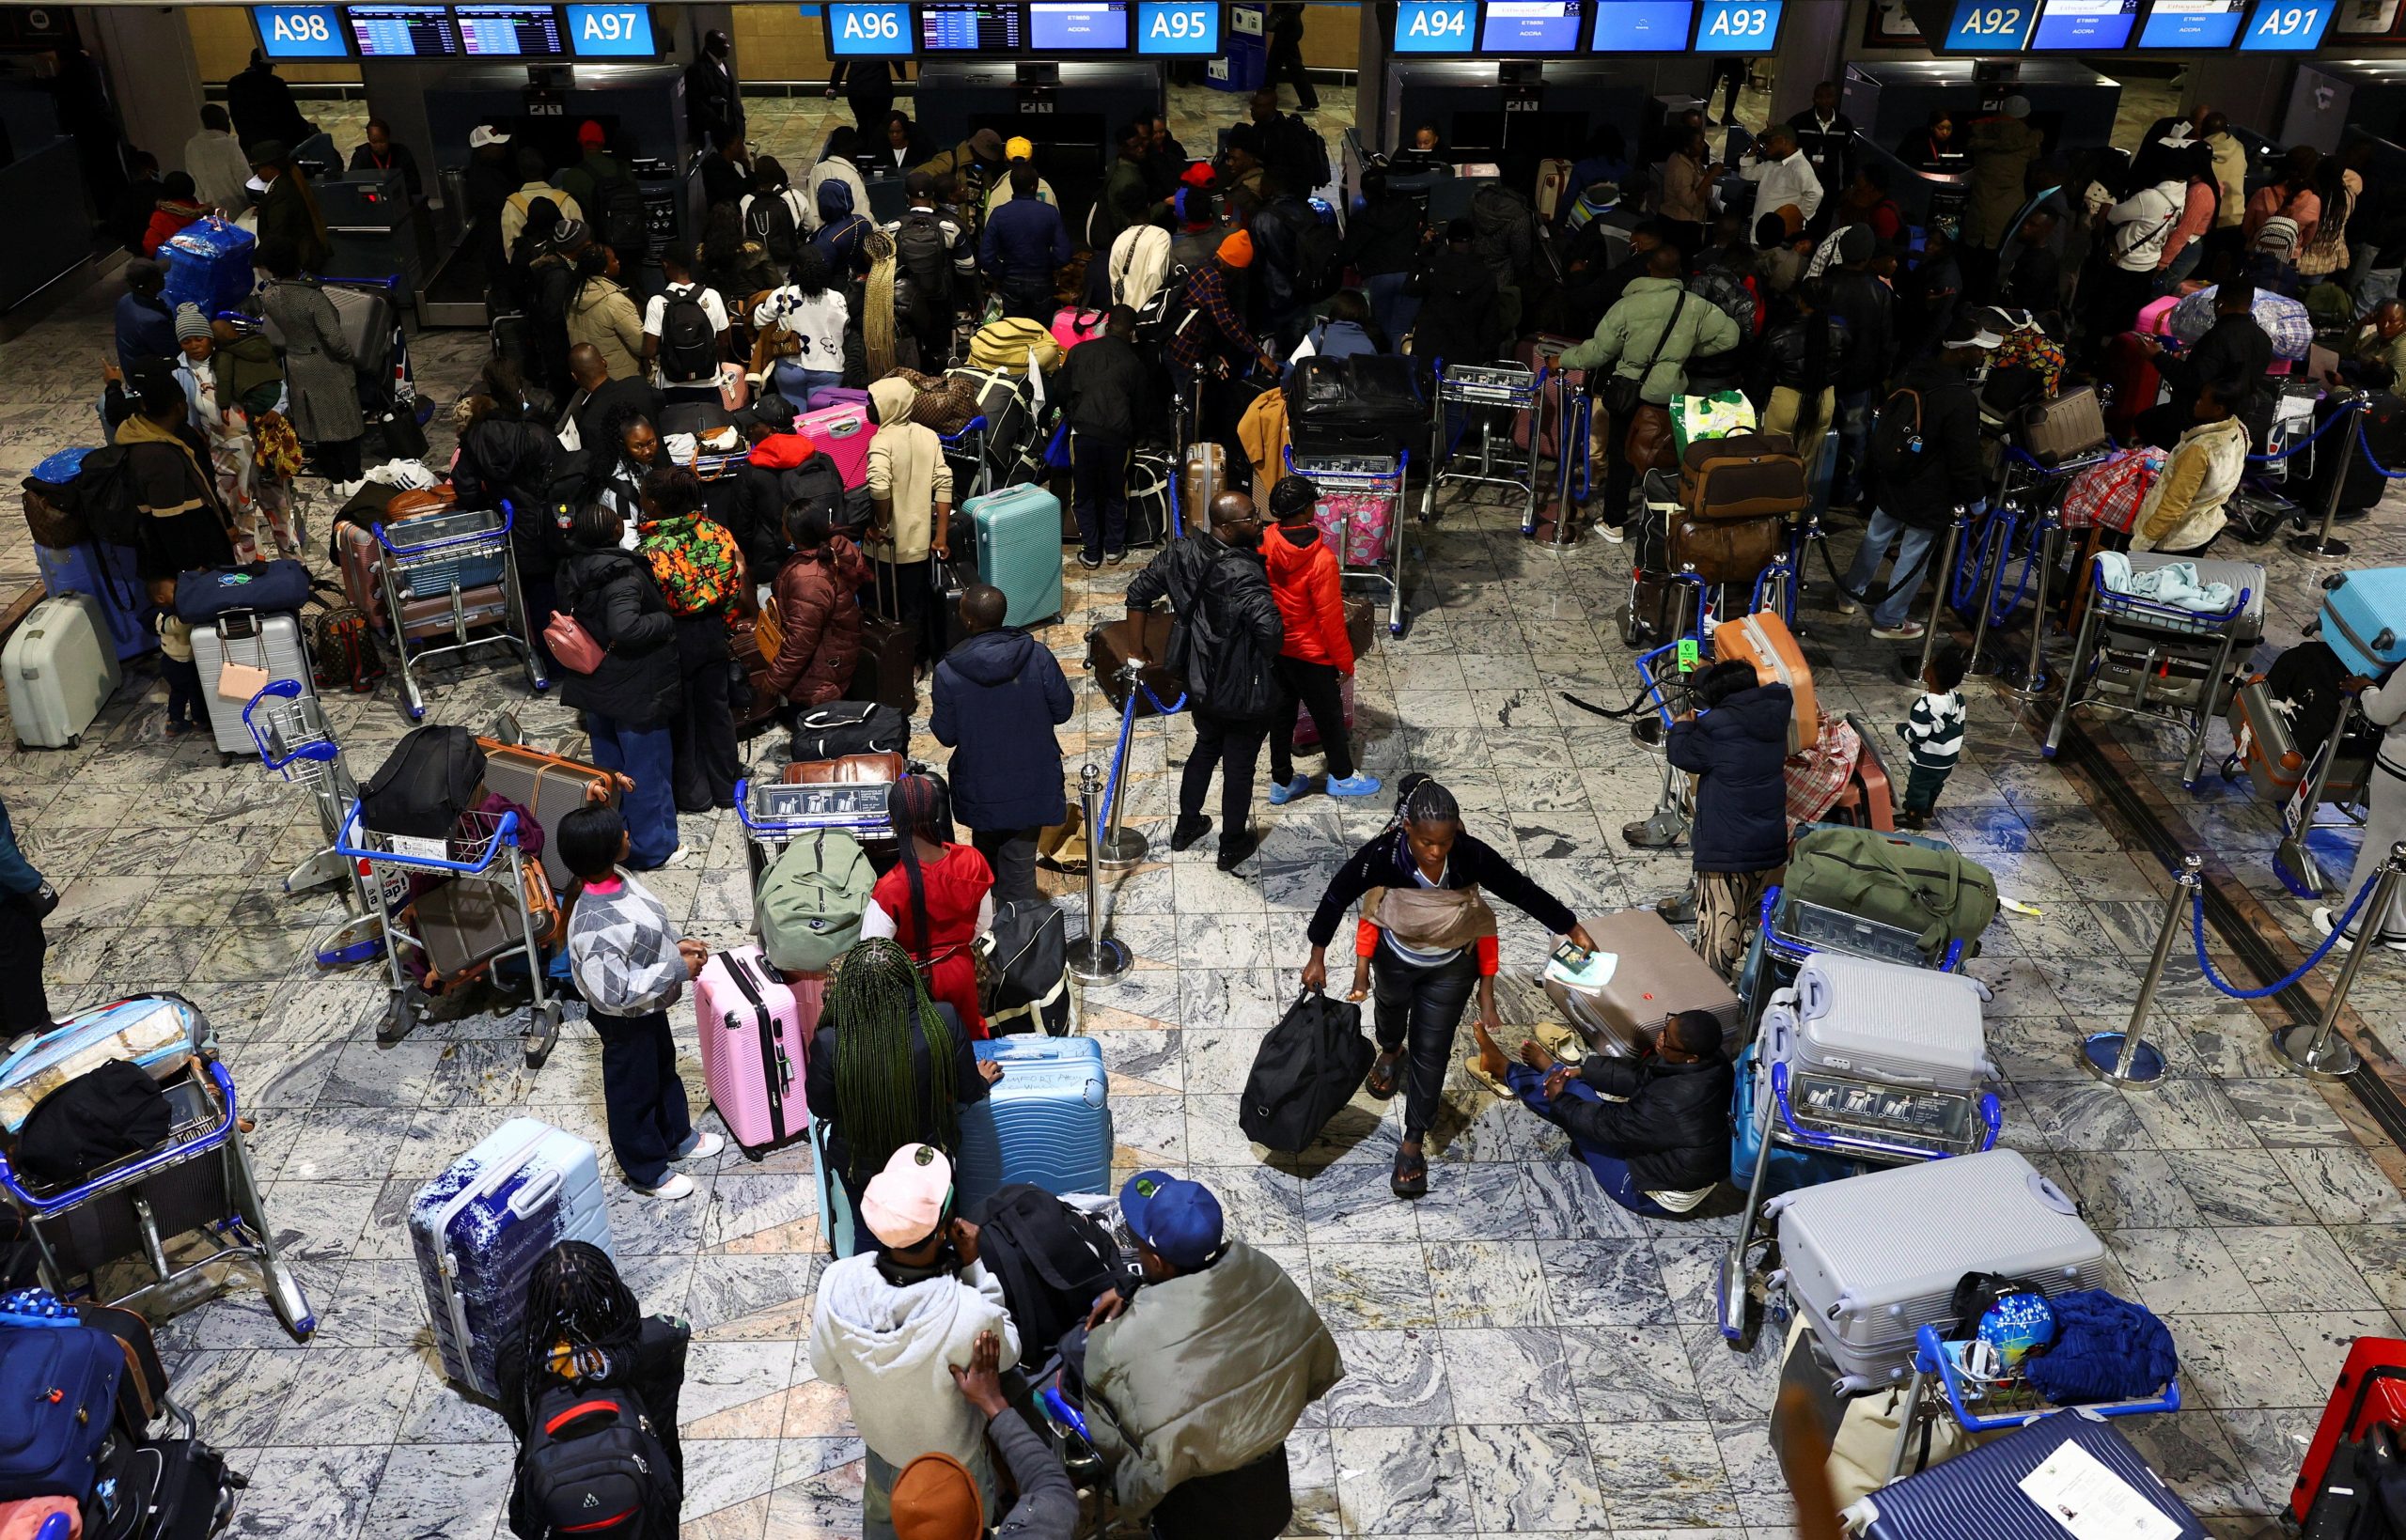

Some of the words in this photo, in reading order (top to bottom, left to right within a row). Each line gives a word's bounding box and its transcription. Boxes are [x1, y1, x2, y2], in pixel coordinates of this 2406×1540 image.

[274, 14, 330, 41] A98
[584, 13, 636, 40] A97
[843, 12, 899, 39] A96
[1149, 11, 1206, 39] A95
[1408, 9, 1466, 37] A94
[1709, 8, 1767, 36] A93
[1961, 8, 2020, 34] A92
[2258, 8, 2318, 36] A91
[369, 877, 408, 906] aap!
